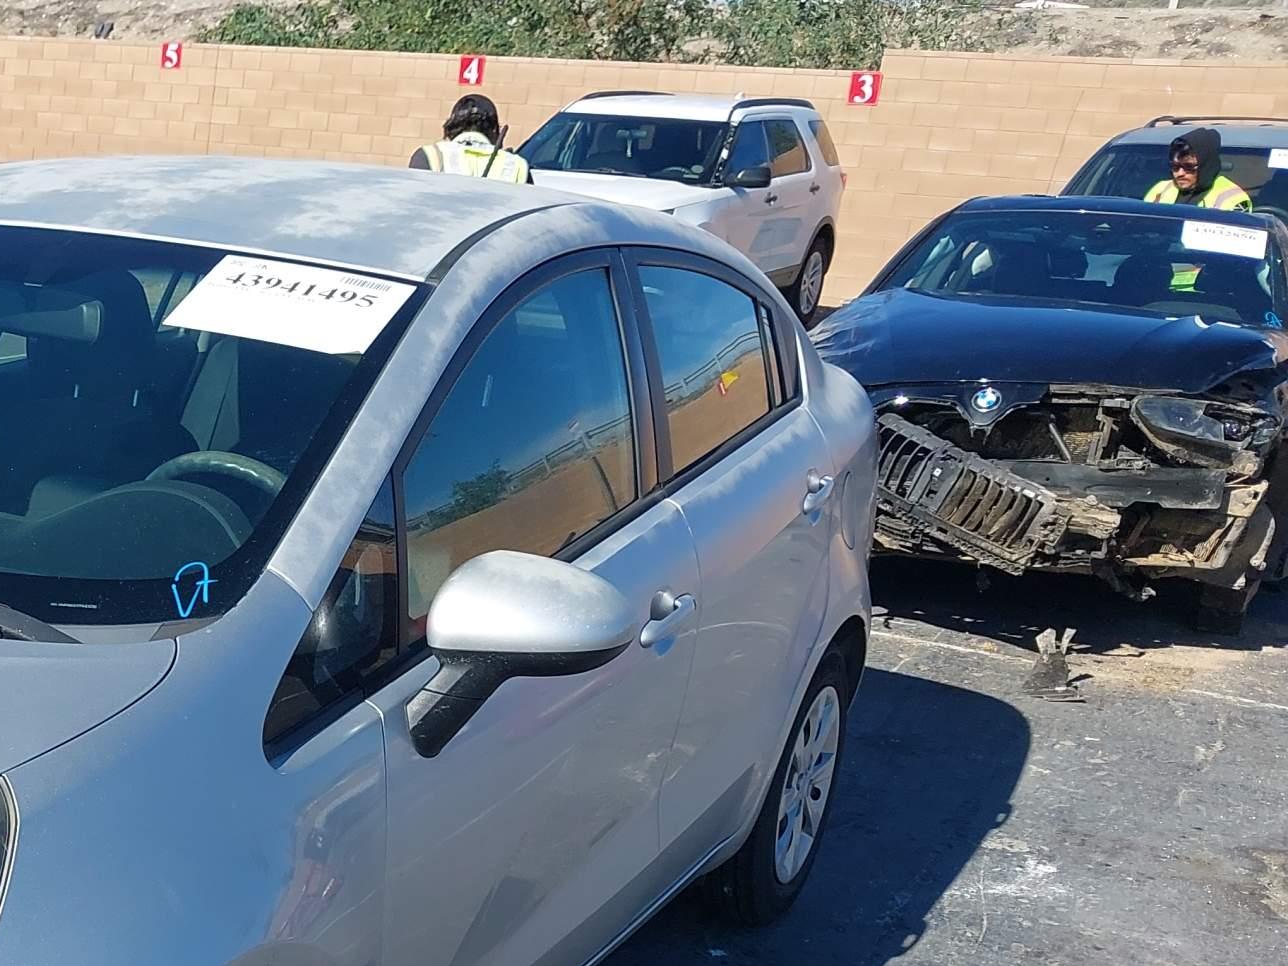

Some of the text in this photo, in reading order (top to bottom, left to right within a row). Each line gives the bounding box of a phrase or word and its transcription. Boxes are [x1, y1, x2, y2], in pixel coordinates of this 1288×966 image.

[164, 43, 179, 68] 5
[463, 57, 479, 84] 4
[853, 74, 874, 103] 3
[225, 272, 379, 308] 43941495
